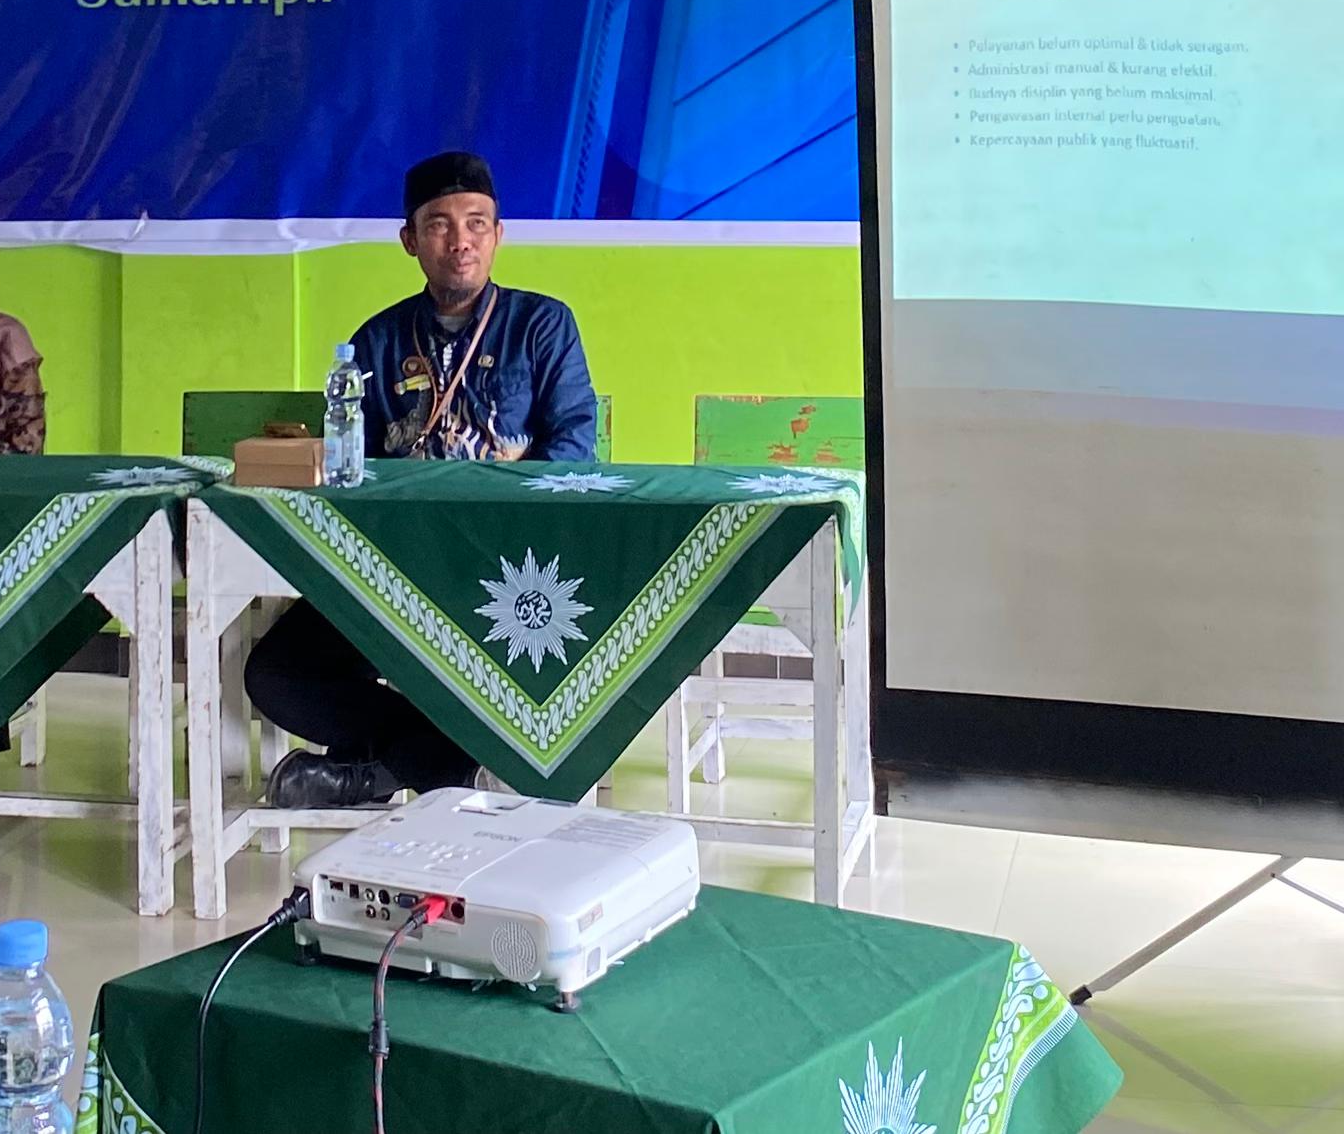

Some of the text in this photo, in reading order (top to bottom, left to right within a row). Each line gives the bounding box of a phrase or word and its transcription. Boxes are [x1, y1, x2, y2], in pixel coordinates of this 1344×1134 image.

[1038, 36, 1080, 51] belum
[1150, 39, 1184, 52] tidak
[1054, 61, 1104, 74] manual
[1122, 61, 1167, 77] kurang
[1070, 87, 1102, 101] yang
[1109, 109, 1144, 124] perlu
[970, 134, 1053, 148] Kepercayaan
[1057, 133, 1097, 147] publik
[1101, 136, 1133, 150] yang
